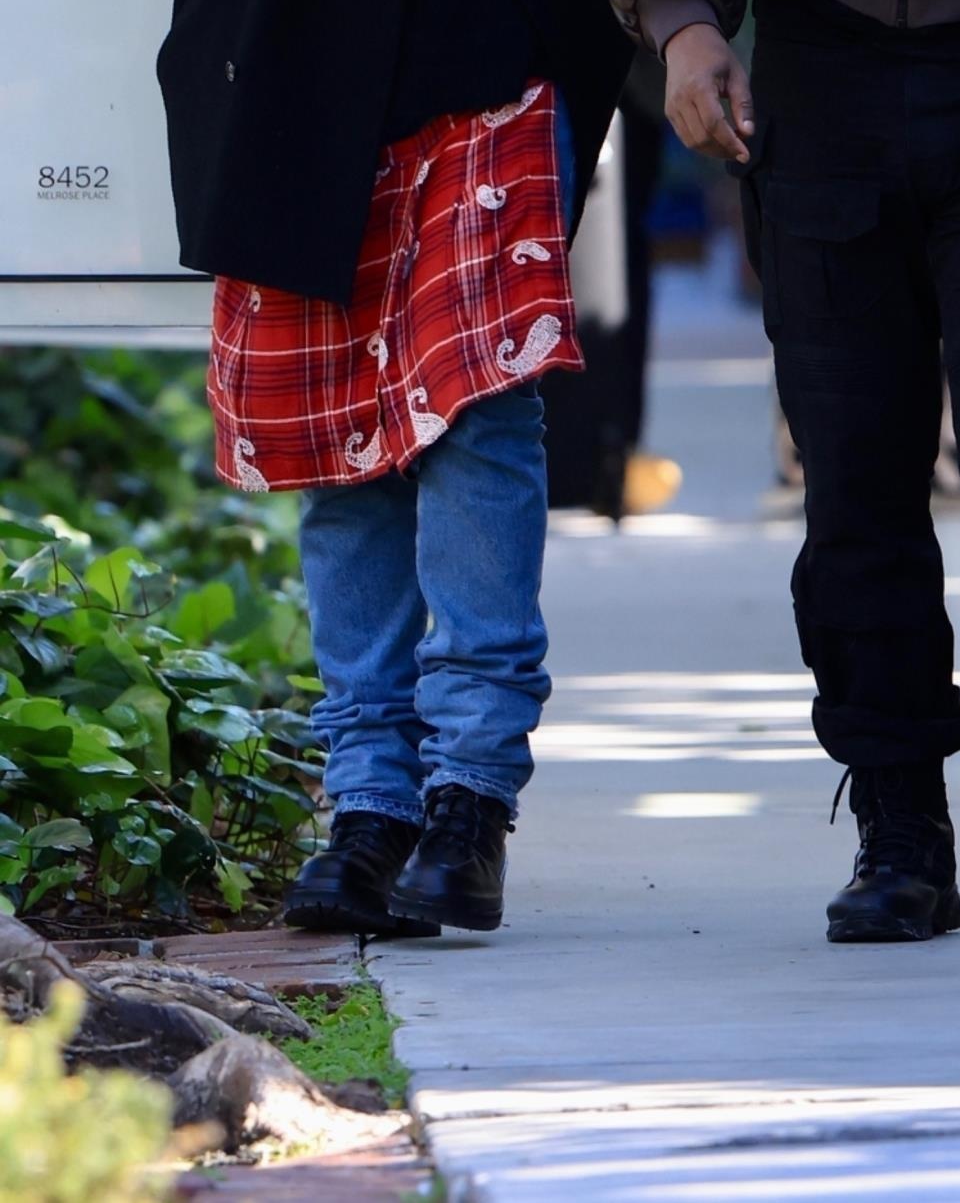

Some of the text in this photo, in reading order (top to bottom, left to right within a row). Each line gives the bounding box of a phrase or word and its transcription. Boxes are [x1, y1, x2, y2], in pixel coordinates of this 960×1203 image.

[38, 165, 109, 188] 8452
[37, 191, 109, 200] MELROSE PLACE
